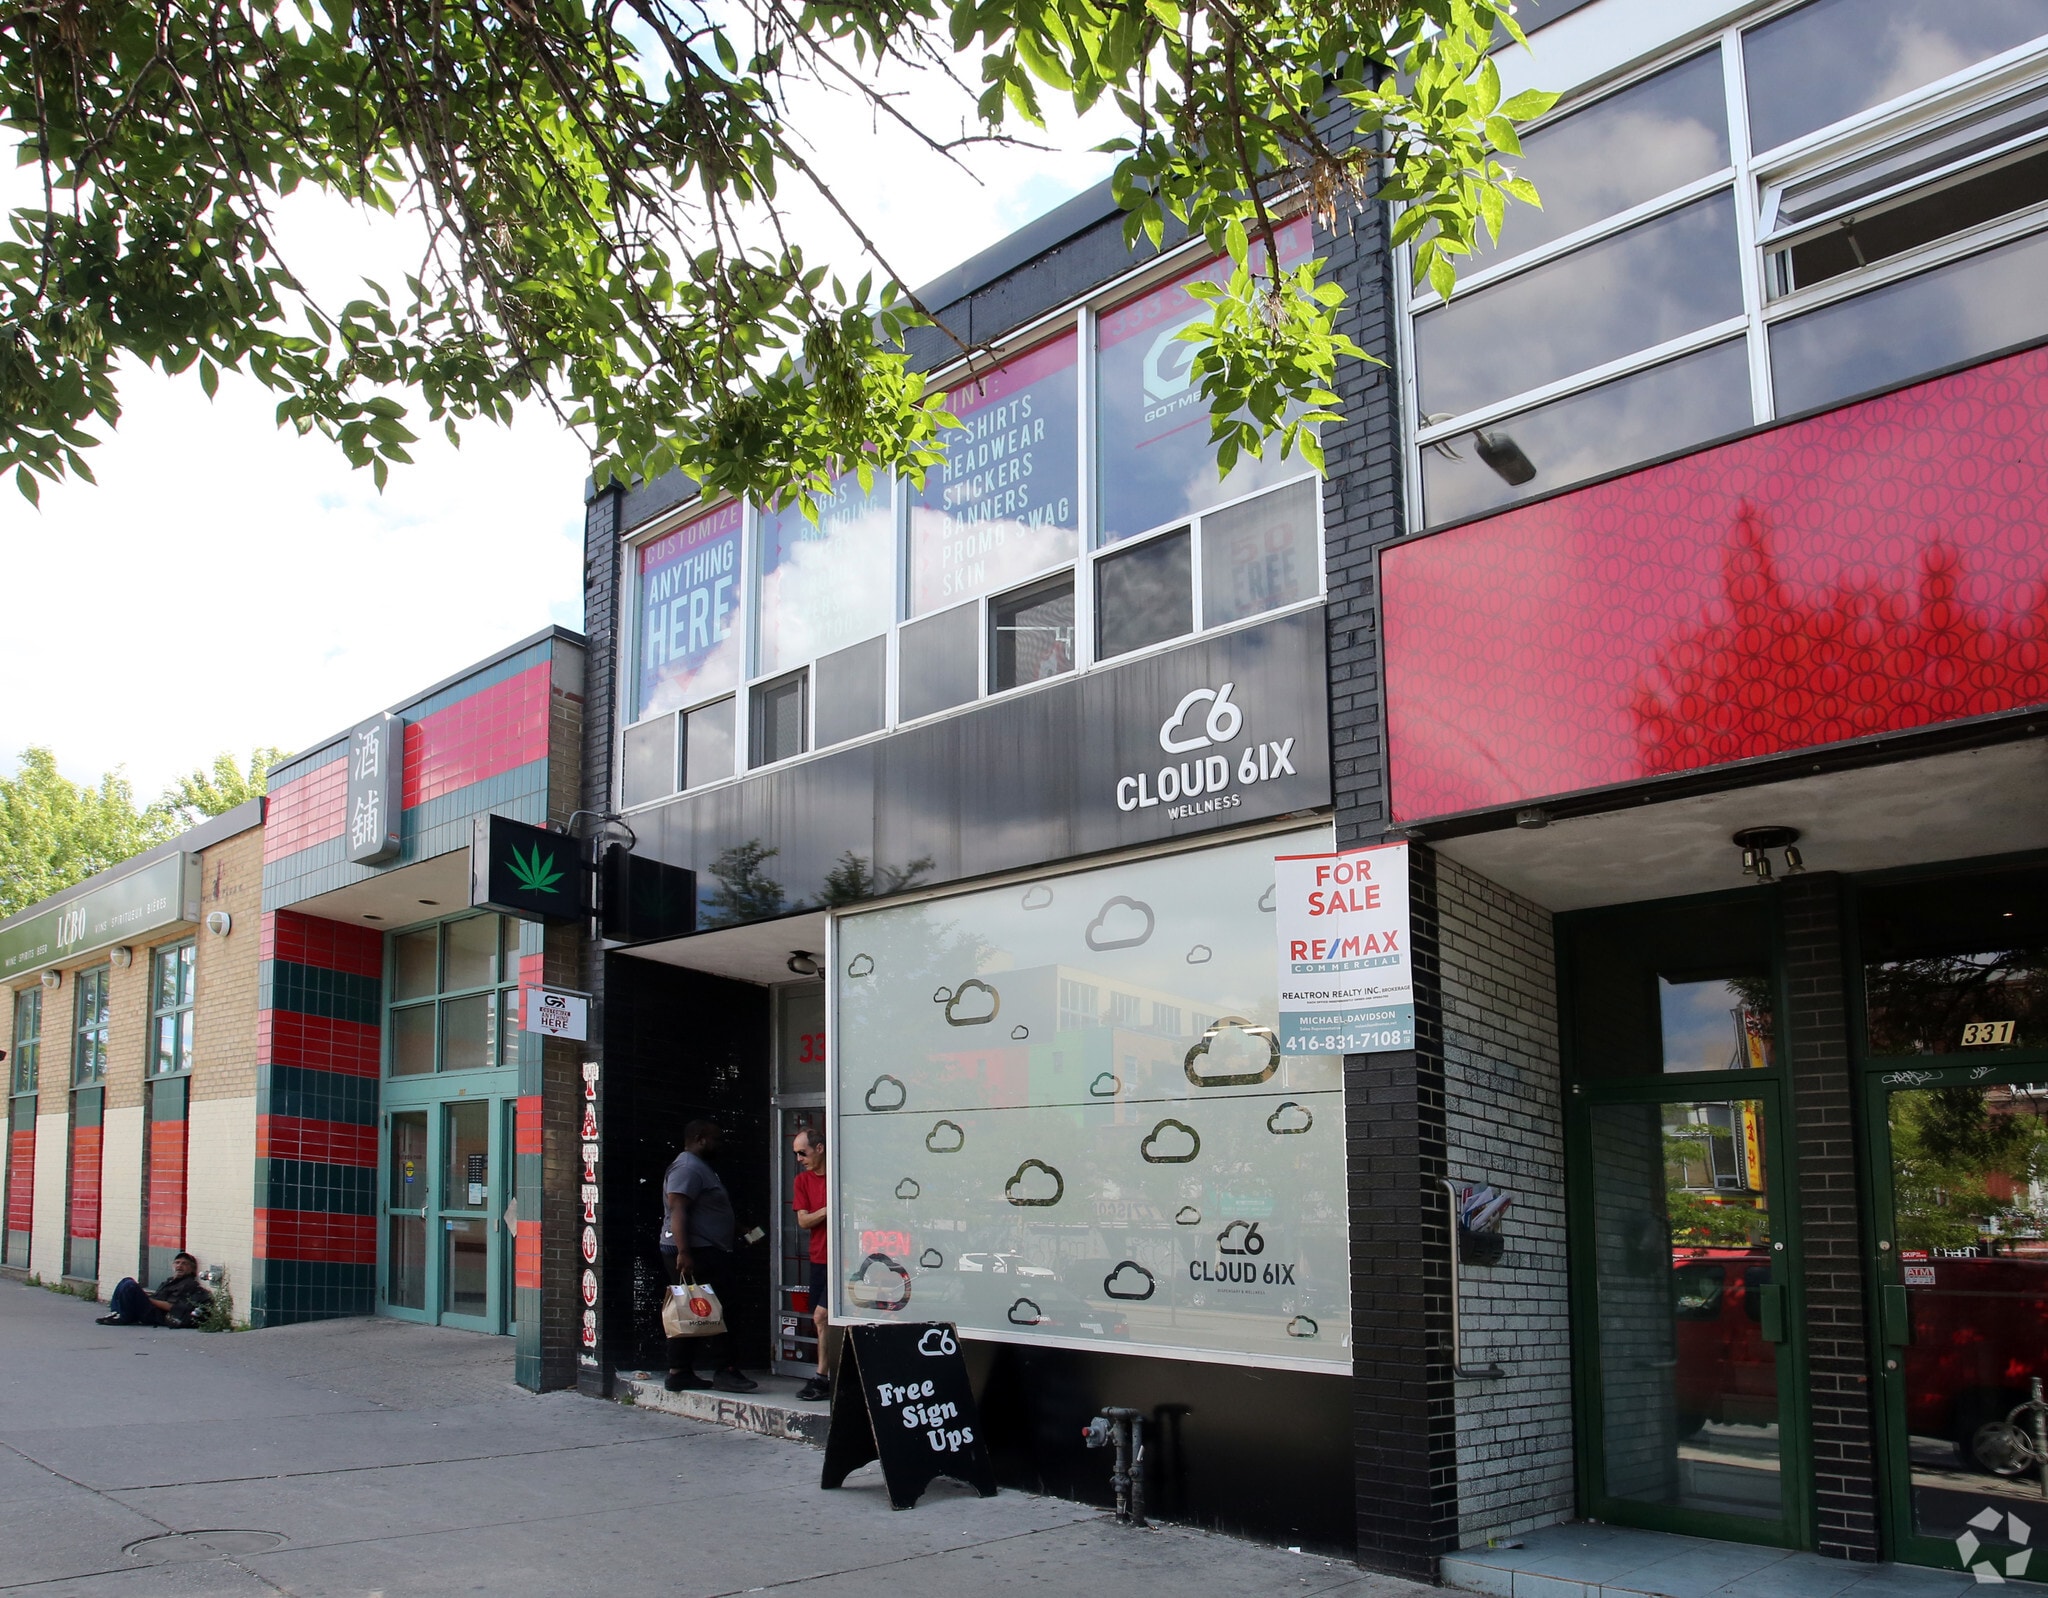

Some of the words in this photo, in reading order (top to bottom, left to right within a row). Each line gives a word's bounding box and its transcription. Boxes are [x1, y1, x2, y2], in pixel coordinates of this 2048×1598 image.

[942, 394, 1032, 455] T-SHIRTS
[942, 418, 1045, 484] HEADWEAR
[943, 452, 1033, 511] STICKERS
[943, 484, 1028, 540] BANNERS
[646, 504, 739, 565] CUSTOMIZE
[942, 523, 1006, 568] PROMO
[1015, 497, 1070, 539] SWAG
[649, 540, 735, 606] ANYTHING
[943, 560, 985, 596] SKIN
[647, 574, 733, 670] HERE
[1116, 755, 1230, 812] CLOUD
[1237, 737, 1297, 785] 6IX
[1167, 793, 1242, 820] WELLNESS
[1316, 860, 1372, 887] FOR
[1308, 884, 1381, 917] SALE
[57, 907, 86, 948] LCBO
[19, 949, 34, 962] SPIRITS
[37, 944, 48, 955] BEER
[1290, 930, 1400, 961] RE/MAX
[1295, 956, 1398, 973] COMMERCIAL
[1282, 991, 1330, 1000] REALTRON
[1332, 988, 1362, 998] REALTY
[1381, 985, 1411, 993] BROKERAGE
[541, 1018, 568, 1028] HERE
[1300, 1015, 1344, 1025] MICHAEL
[1347, 1011, 1396, 1023] DAVIDSON
[1286, 1030, 1401, 1051] 416-831-7108
[1965, 1022, 2009, 1044] 331
[581, 1062, 599, 1348] TATTOOS
[862, 1230, 911, 1256] OPEN
[1189, 1260, 1257, 1285] CLOUD
[1262, 1263, 1296, 1286] 6IX
[1908, 1268, 1930, 1277] ATM
[877, 1380, 935, 1407] Free
[902, 1402, 958, 1428] Sign
[927, 1427, 974, 1452] Ups
